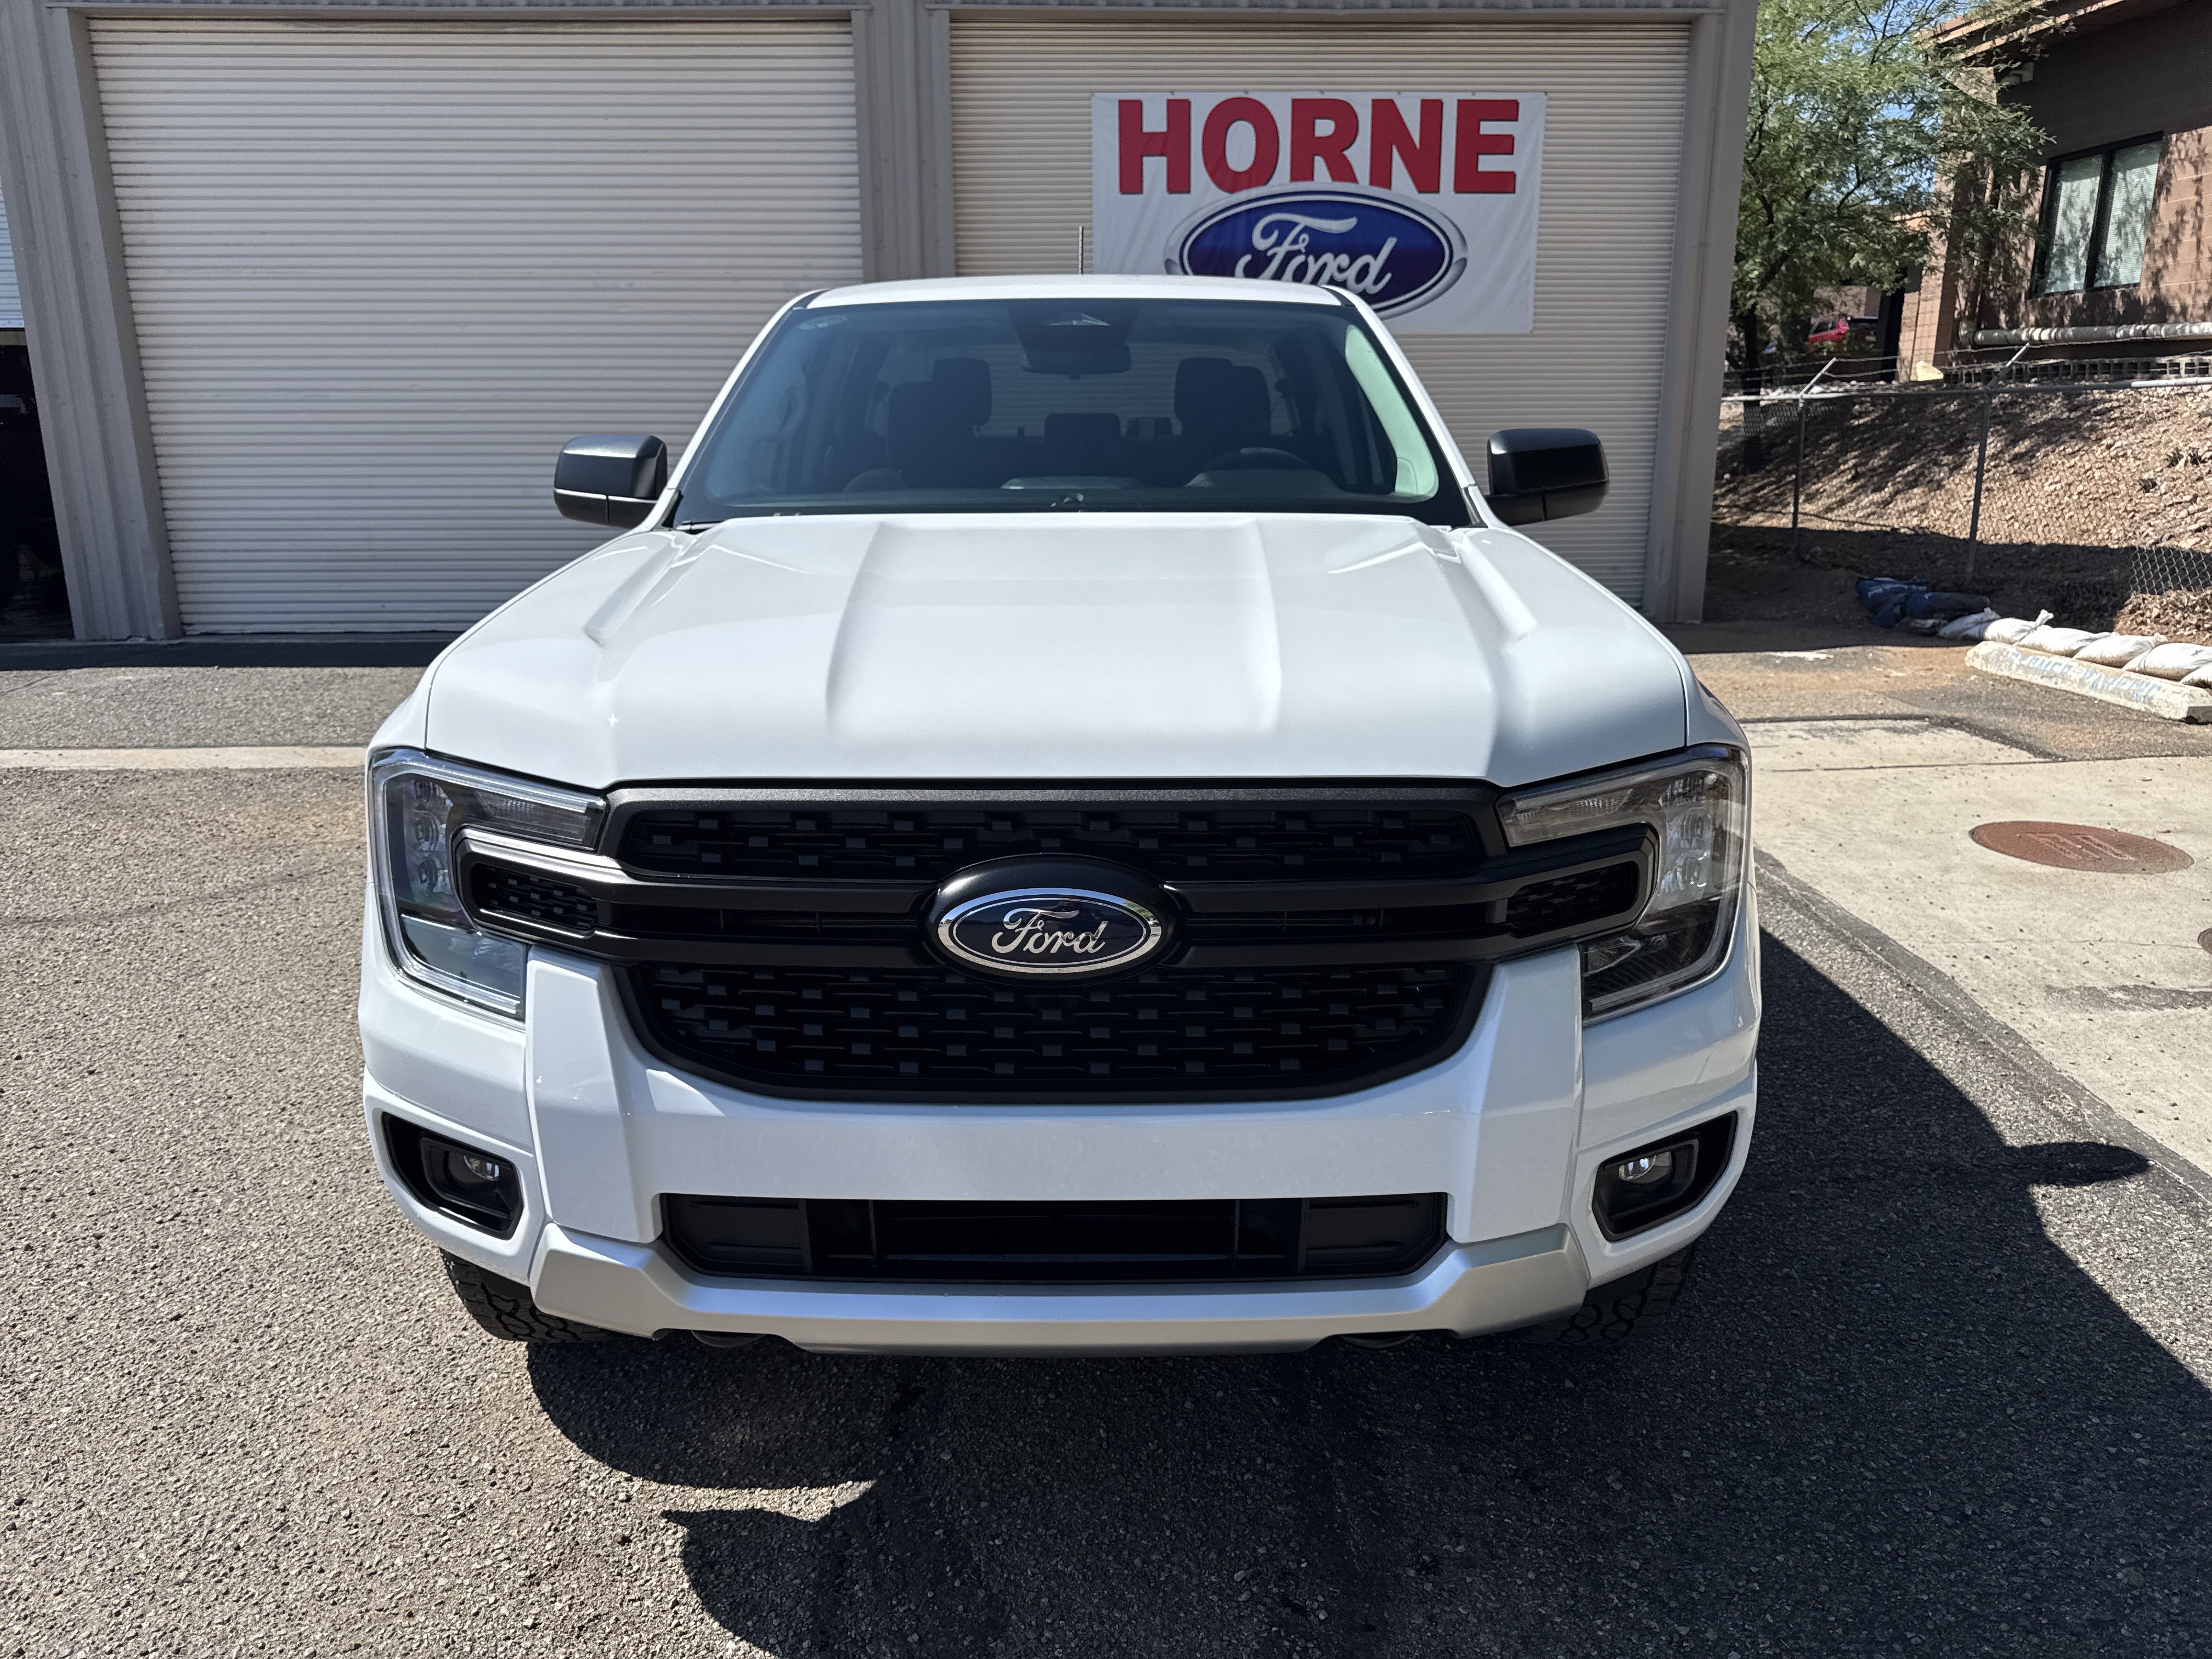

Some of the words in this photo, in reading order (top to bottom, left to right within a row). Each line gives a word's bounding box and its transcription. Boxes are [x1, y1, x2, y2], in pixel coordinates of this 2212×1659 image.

[1118, 97, 1520, 194] HORNE
[1235, 213, 1397, 295] Ford
[991, 908, 1109, 953] Ford
